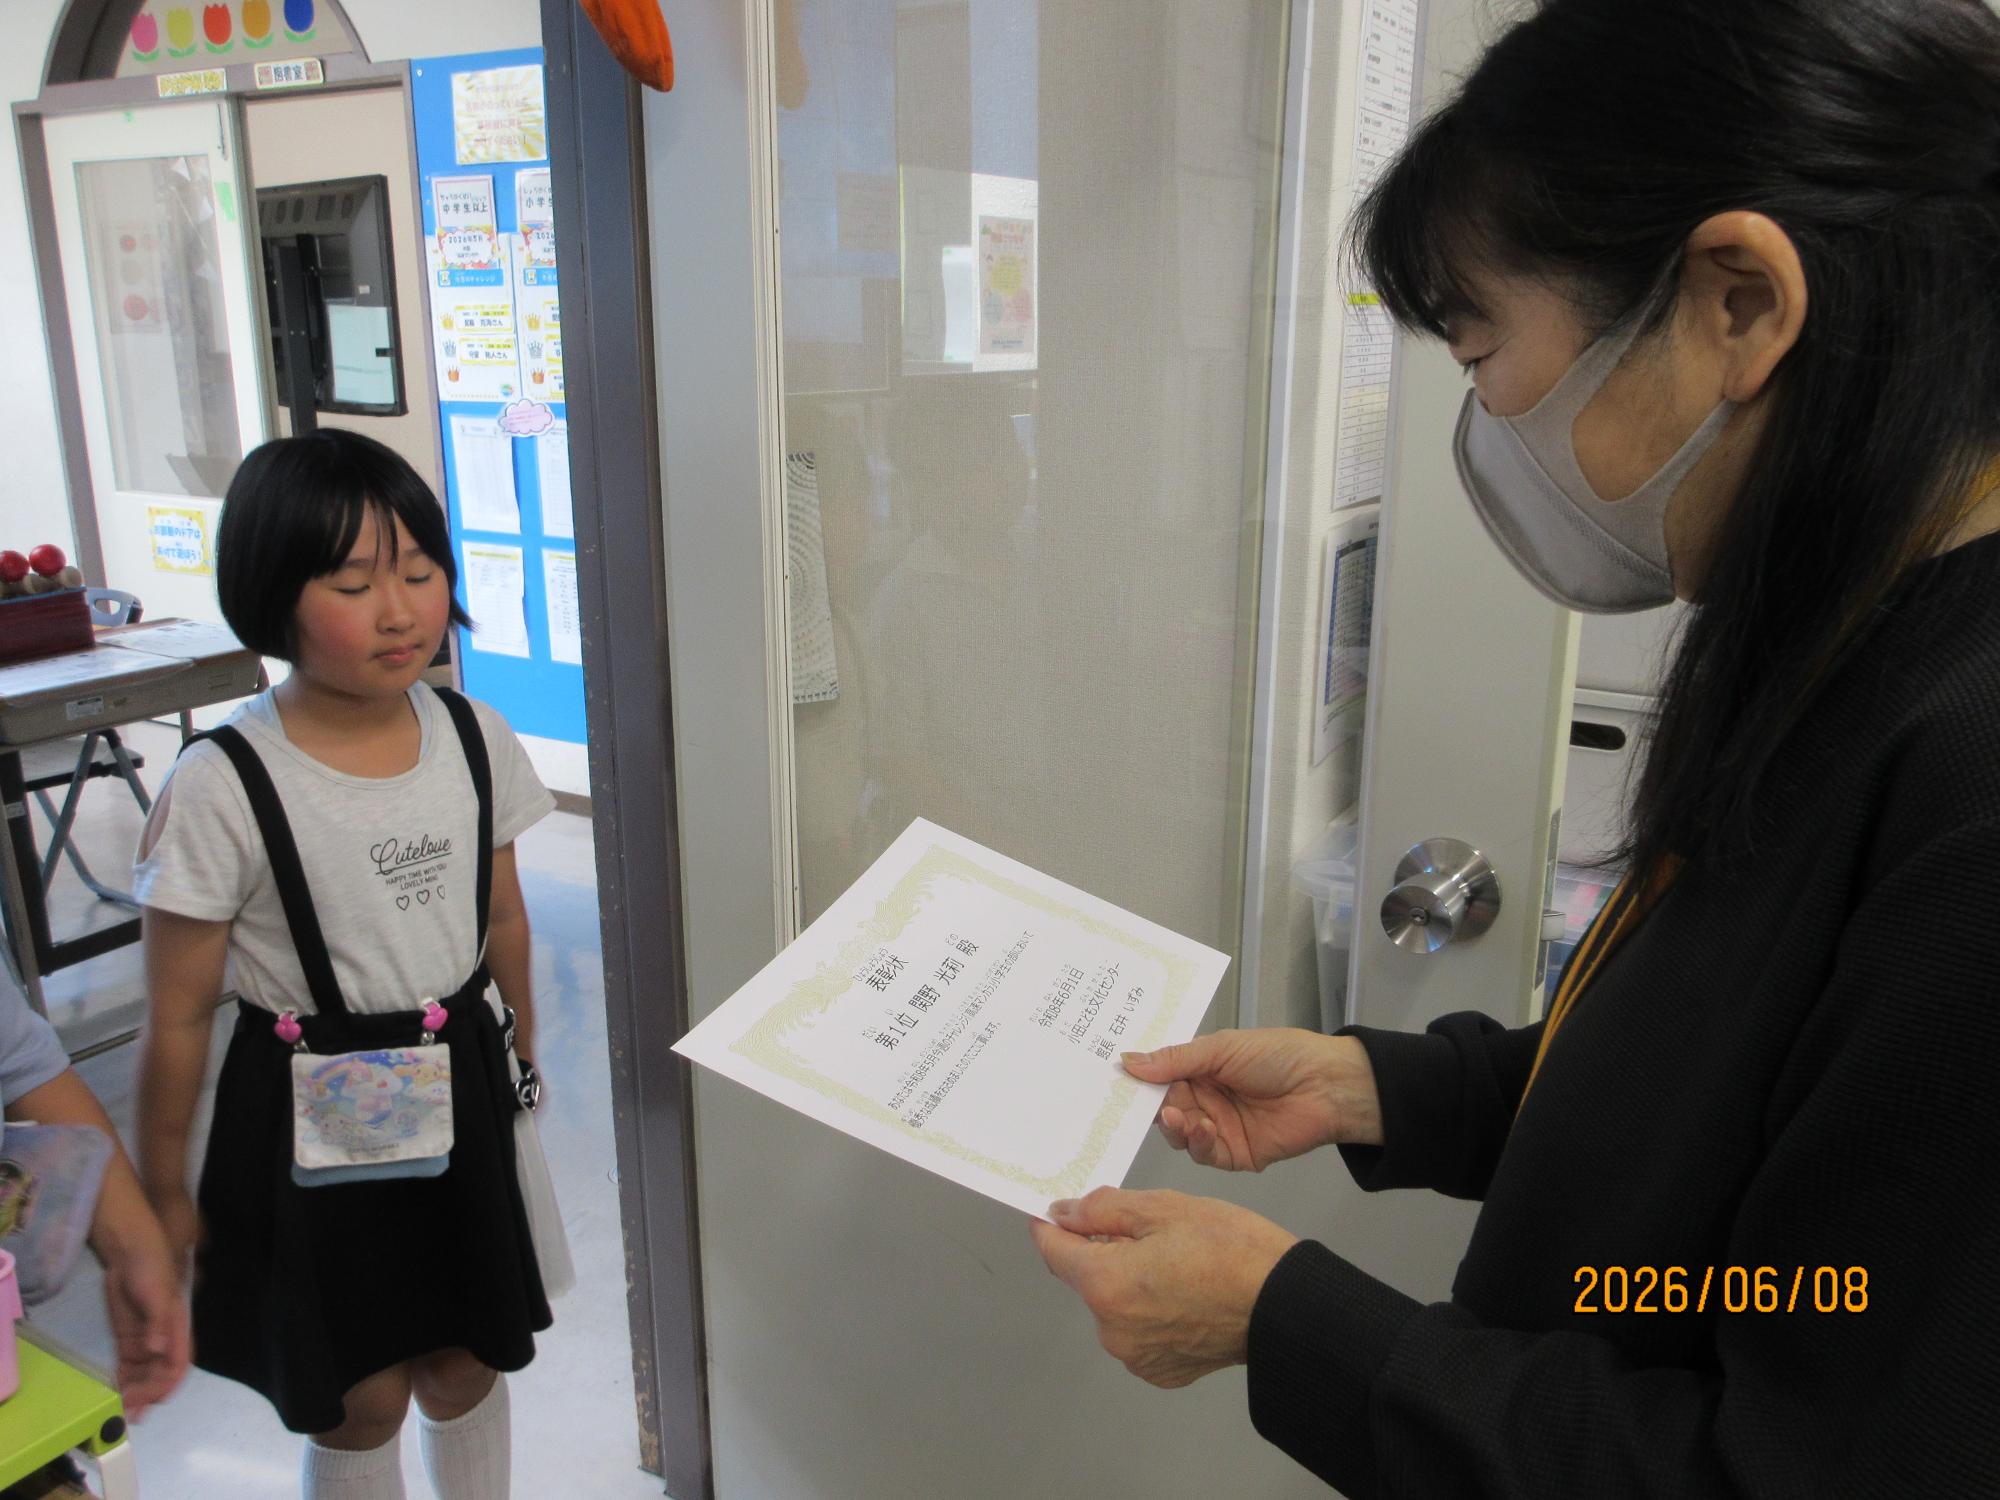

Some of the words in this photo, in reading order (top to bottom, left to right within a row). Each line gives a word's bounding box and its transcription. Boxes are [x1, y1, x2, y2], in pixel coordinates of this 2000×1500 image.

[442, 203, 488, 215] 中学生以上
[386, 875, 406, 886] HAPPY
[408, 869, 422, 879] TIME
[400, 878, 424, 890] LOVELY
[864, 954, 909, 992] 表彰状
[874, 1011, 920, 1051] 第1位
[908, 984, 942, 1014] 関野
[932, 955, 966, 986] 光莉
[955, 938, 979, 958] 殿
[1039, 968, 1086, 1029] 令和8年6月1日
[1068, 962, 1120, 1046] 小田こども文化センター
[1095, 1039, 1118, 1060] 館長
[1108, 1014, 1128, 1037] 石井
[1123, 986, 1144, 1011] いずみ
